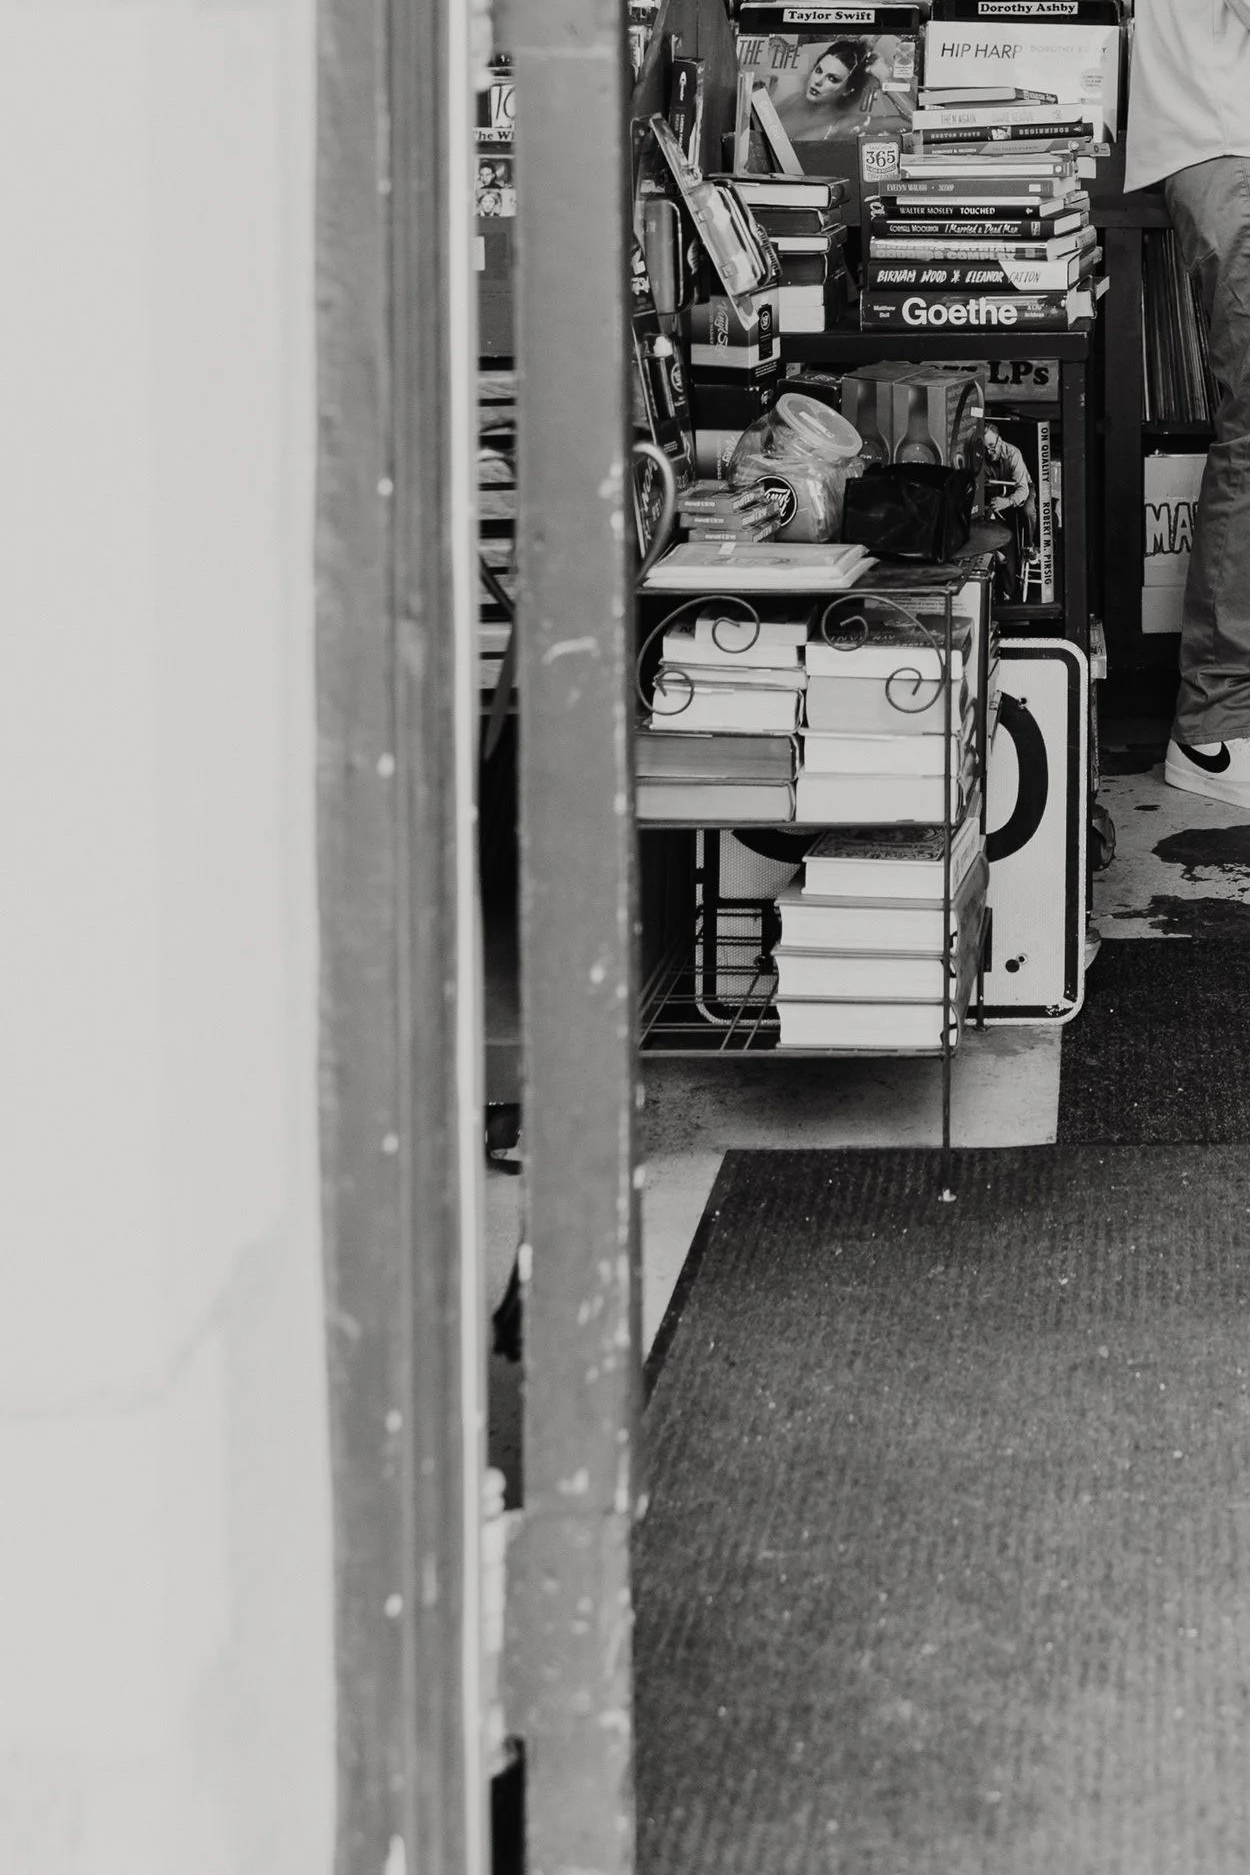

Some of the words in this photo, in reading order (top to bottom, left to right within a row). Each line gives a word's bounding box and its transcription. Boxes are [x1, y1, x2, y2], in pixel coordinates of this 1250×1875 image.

[788, 9, 831, 21] Taylor
[834, 10, 872, 21] Swift
[980, 3, 1033, 14] Dorothy
[1035, 3, 1076, 14] Ashby
[739, 39, 766, 66] THE
[770, 43, 801, 69] LIFE
[941, 43, 972, 58] HIP
[974, 43, 1023, 59] HARP
[1018, 127, 1070, 135] BEGINNINGS
[865, 150, 896, 167] 365
[899, 207, 926, 215] WALTER
[927, 207, 954, 215] MOSLEY
[960, 207, 996, 215] TOUCHED
[949, 223, 977, 234] Married
[983, 223, 1001, 233] Dead
[876, 269, 917, 283] BIRNAM
[920, 269, 948, 283] WOOD
[965, 270, 1003, 283] ELEANOR
[901, 296, 1018, 326] Goethe
[987, 360, 1050, 386] LPs
[1041, 427, 1050, 442] ON
[1041, 444, 1051, 483] QUALITY
[1042, 501, 1052, 536] ROBERT
[1144, 500, 1199, 555] MA
[1043, 539, 1052, 552] M.
[1043, 554, 1053, 586] PIRSIG
